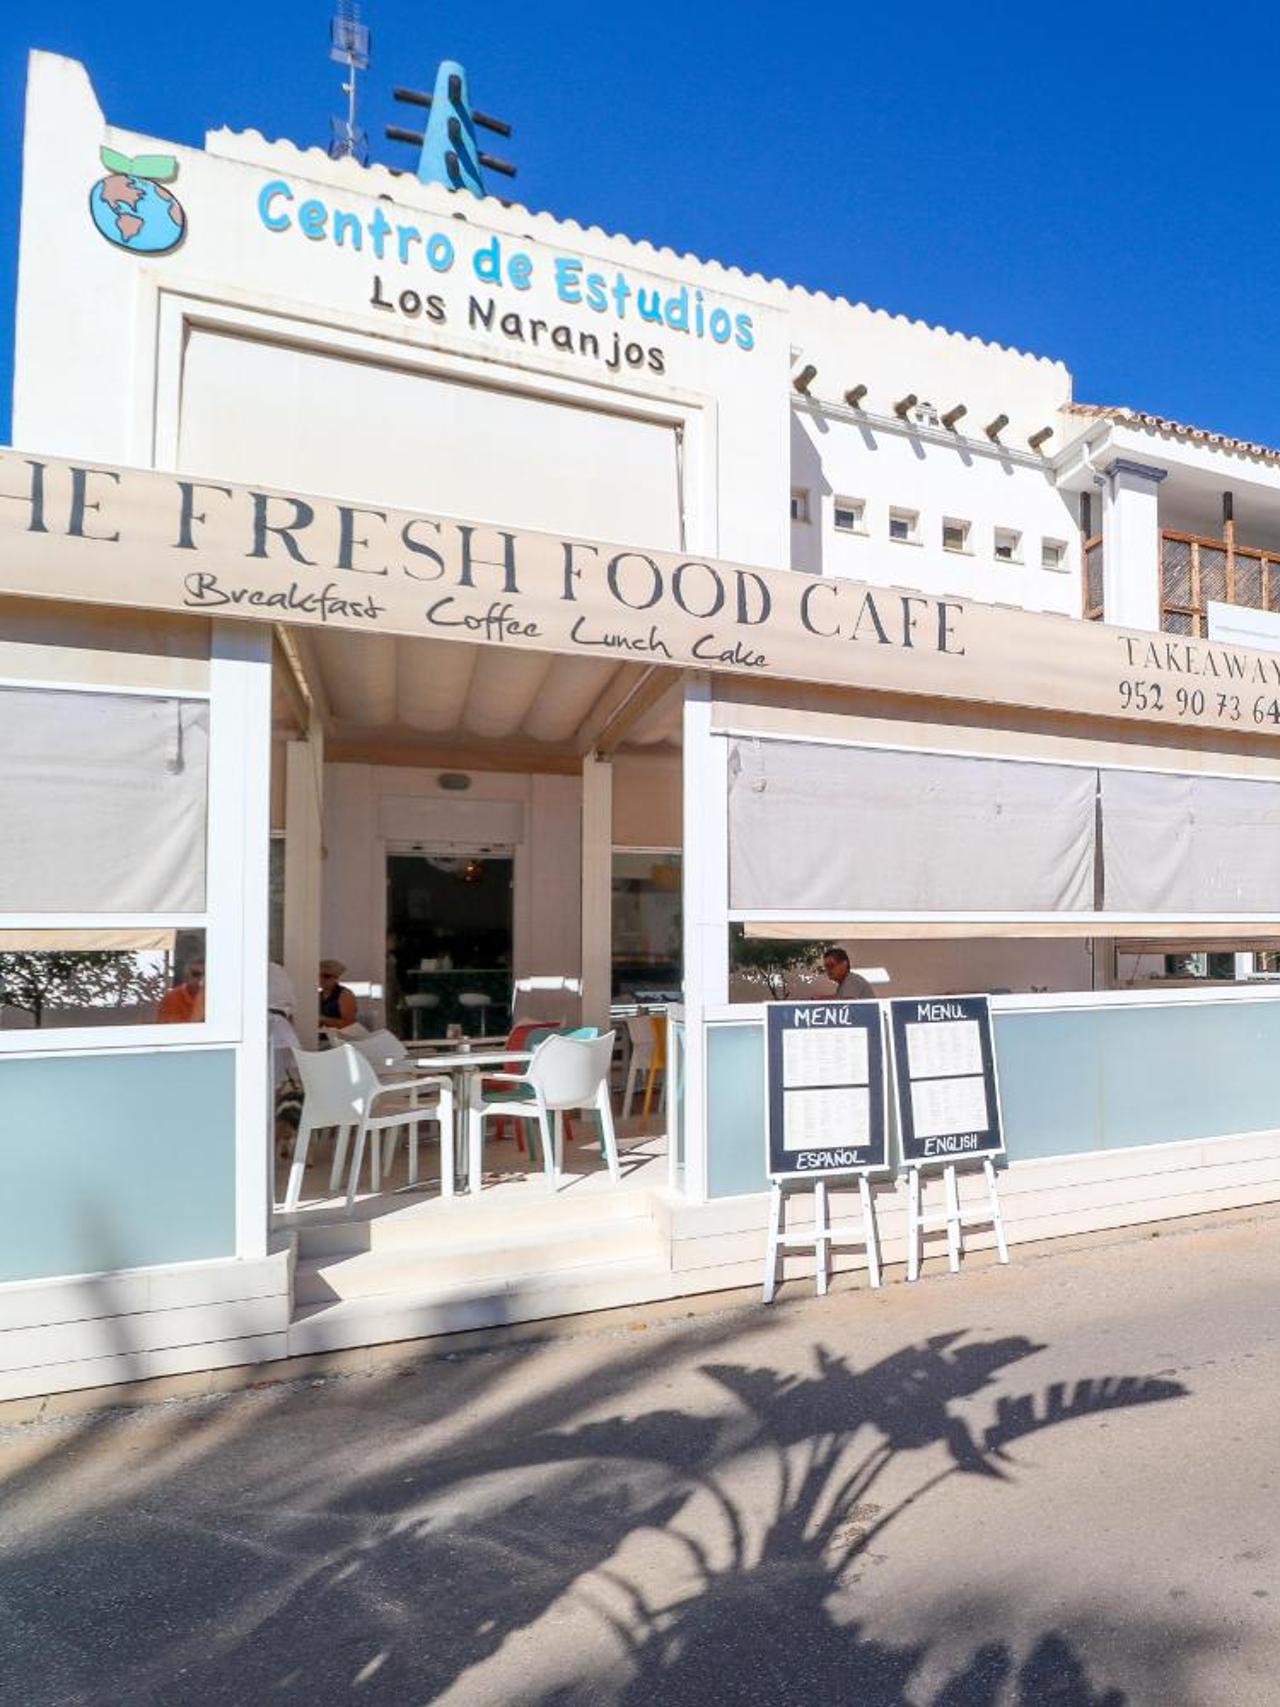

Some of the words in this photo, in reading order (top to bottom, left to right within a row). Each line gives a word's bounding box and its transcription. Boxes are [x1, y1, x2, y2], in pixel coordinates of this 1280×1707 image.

[257, 179, 455, 272] Centro
[472, 235, 534, 290] de
[554, 256, 756, 350] Estudios
[370, 275, 447, 324] Los
[468, 294, 666, 374] Naranjos
[0, 455, 121, 542] HE
[172, 481, 521, 594] FRESH
[560, 541, 772, 626] FOOD
[800, 581, 967, 657] CAFE
[184, 572, 386, 622] Breakfast
[426, 597, 544, 642] Coffee
[571, 616, 671, 658] Lunch
[691, 634, 771, 667] Cake
[1118, 680, 1164, 710] 952
[1176, 687, 1205, 716] 90
[1216, 692, 1242, 721] 73
[794, 1005, 852, 1027] MENÚ
[917, 1003, 967, 1021] MENU
[796, 1148, 866, 1170] ESPAÑOL
[924, 1135, 978, 1156] ENGLISH
